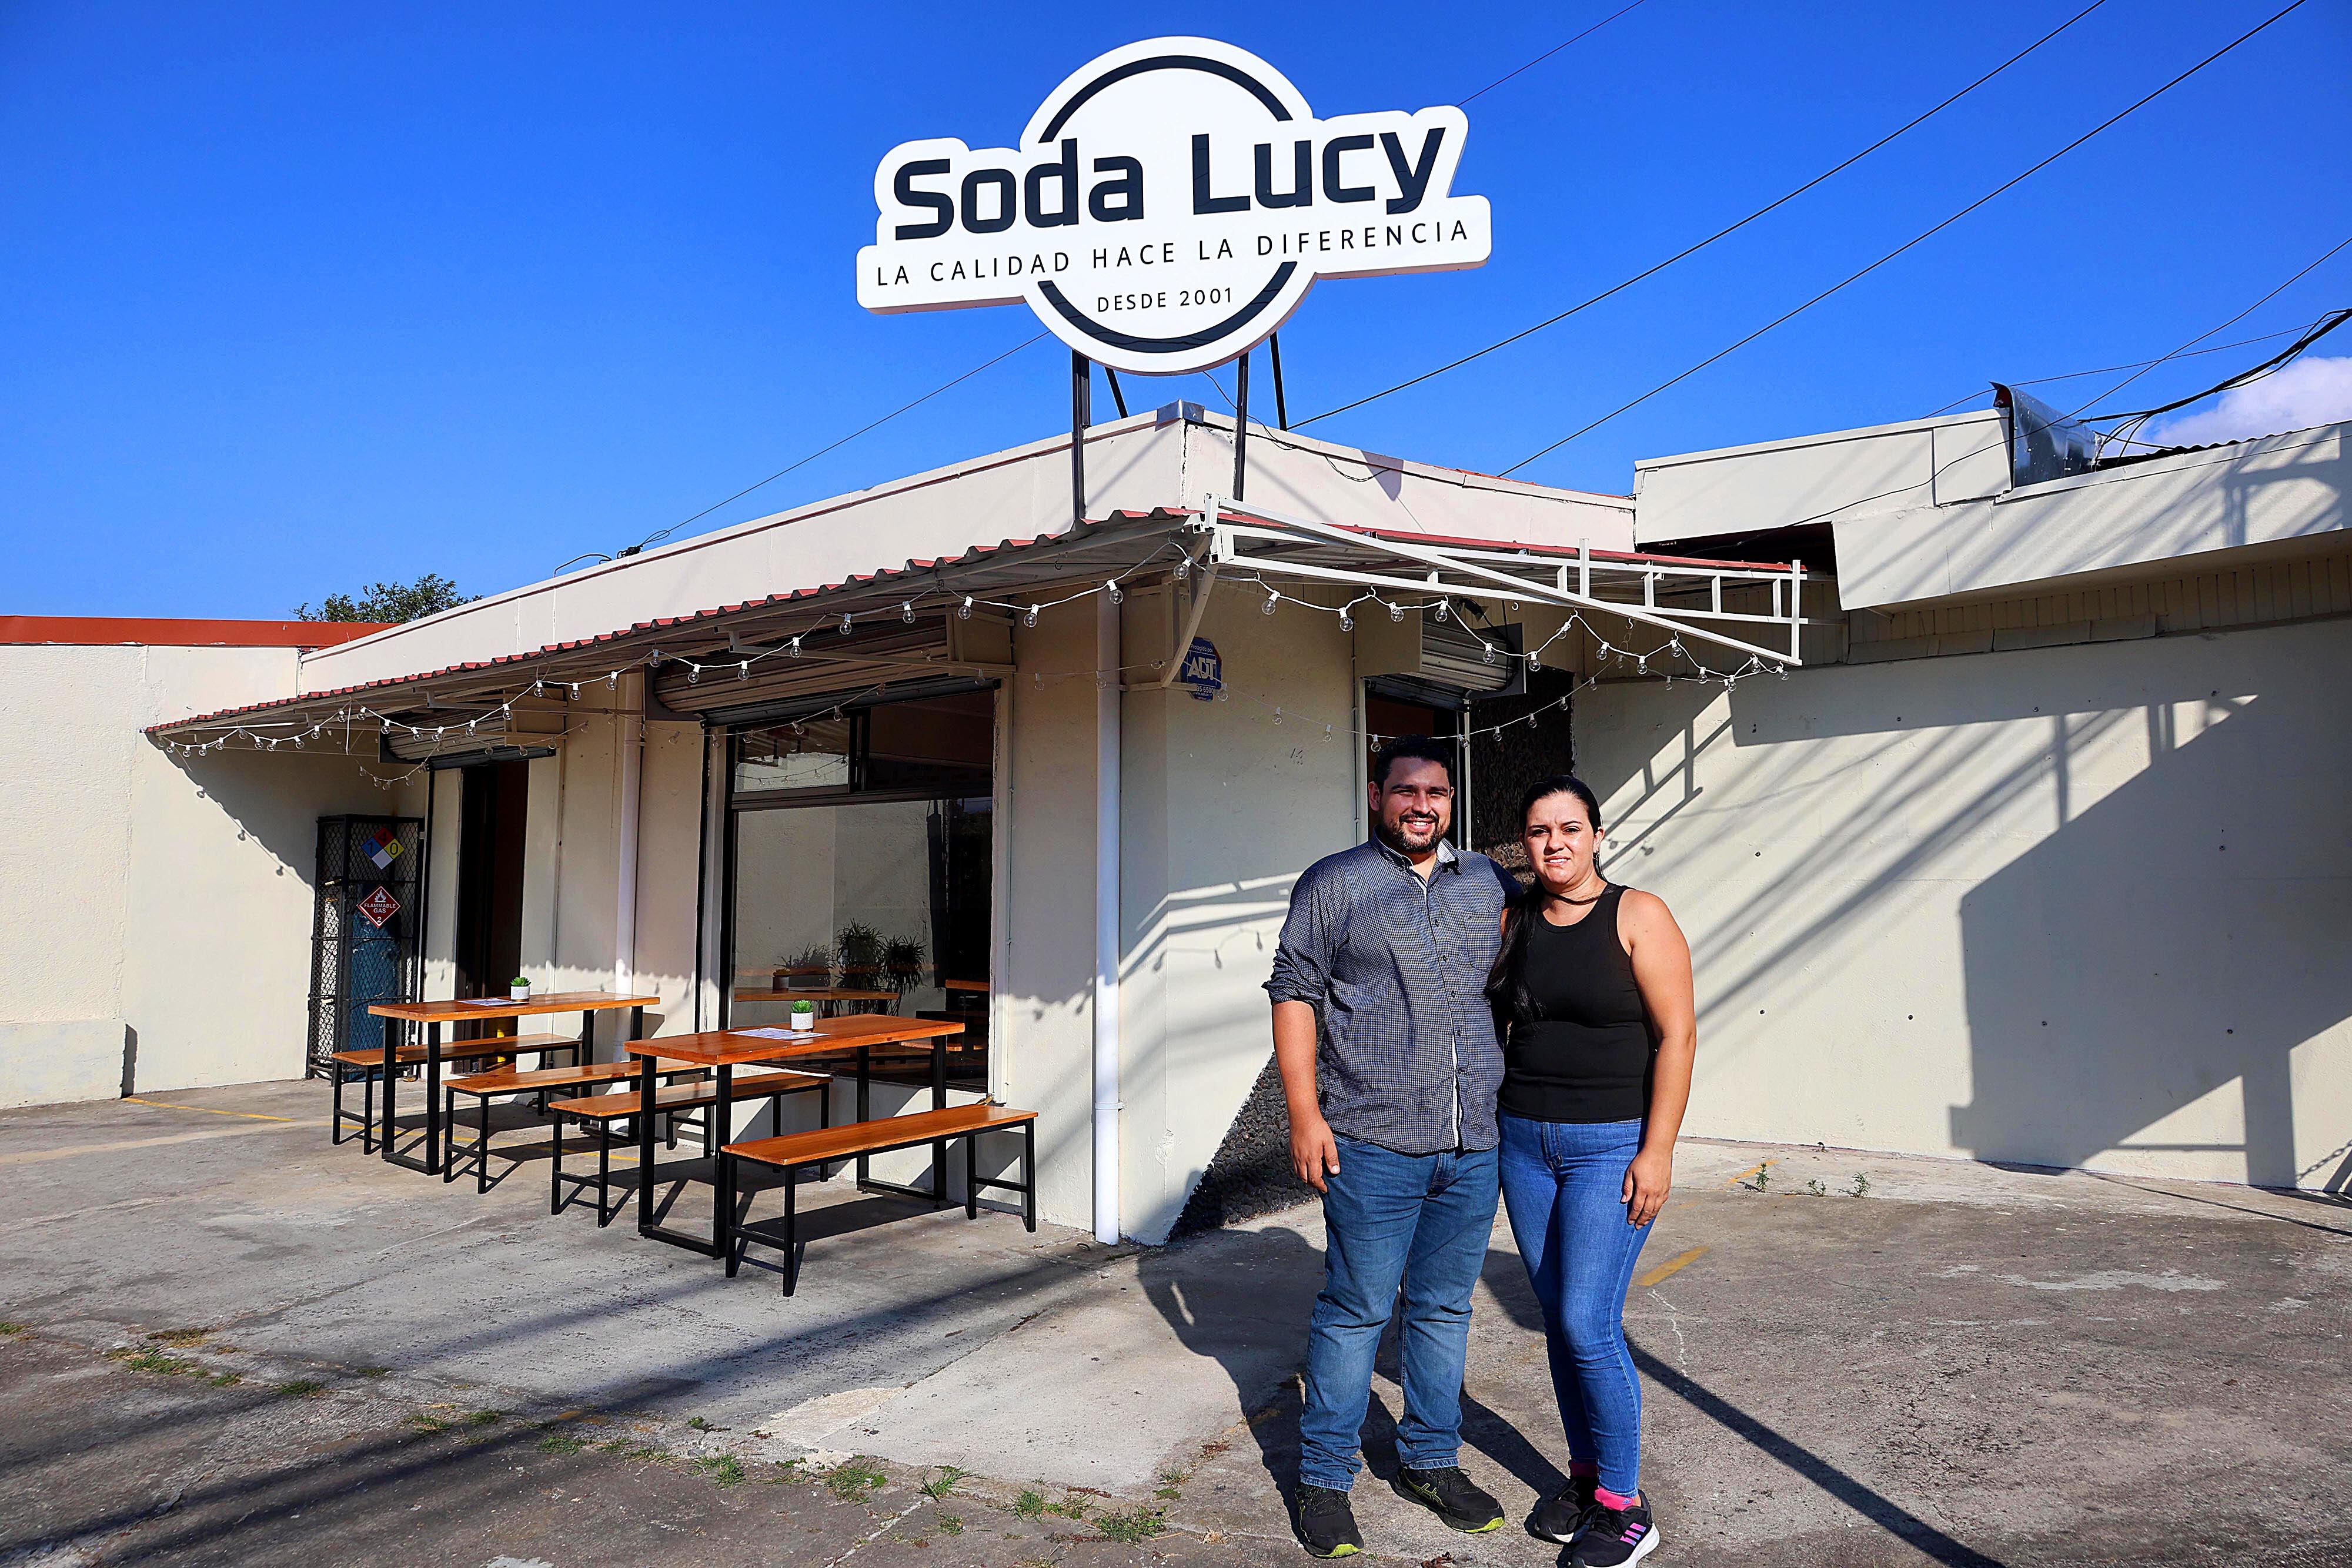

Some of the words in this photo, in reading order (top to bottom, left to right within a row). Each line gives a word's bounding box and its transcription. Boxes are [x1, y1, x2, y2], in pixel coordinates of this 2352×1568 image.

[893, 138, 1144, 241] Soda
[1191, 126, 1446, 216] Lucy
[878, 265, 909, 286] LA
[930, 252, 1069, 282] CALIDAD
[1093, 242, 1174, 269] HACE
[1199, 239, 1233, 260] LA
[1258, 220, 1468, 256] DIFERENCIA
[1098, 292, 1166, 313] DESDE
[1180, 287, 1231, 306] 2001
[1187, 657, 1217, 680] ADT
[368, 841, 374, 854] 1
[378, 831, 387, 842] 4
[390, 842, 399, 855] 0
